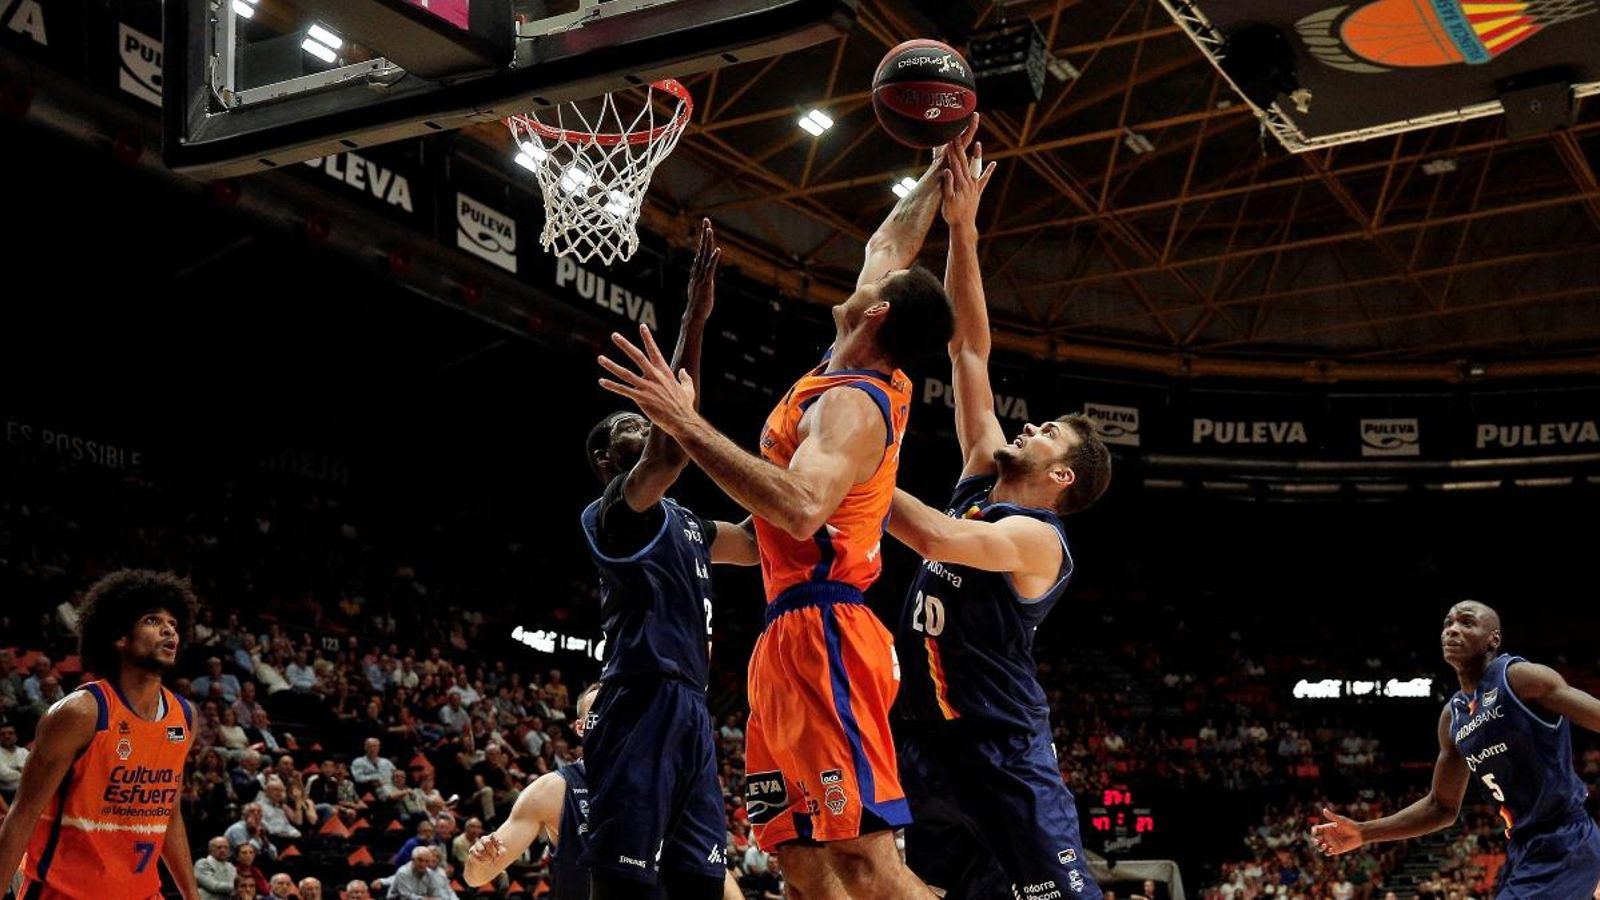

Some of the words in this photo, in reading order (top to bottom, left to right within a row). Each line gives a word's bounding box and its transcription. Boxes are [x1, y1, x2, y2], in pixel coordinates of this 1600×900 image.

[303, 153, 414, 214] LEVA
[461, 201, 512, 239] PULEVA
[556, 257, 658, 331] PULEVA
[1193, 418, 1307, 443] PULEVA
[1364, 422, 1416, 434] PULEVA
[1476, 421, 1599, 448] PULEVA
[912, 590, 946, 637] 20
[109, 765, 174, 784] Cultura
[1481, 773, 1504, 801] 5
[132, 841, 156, 874] 7
